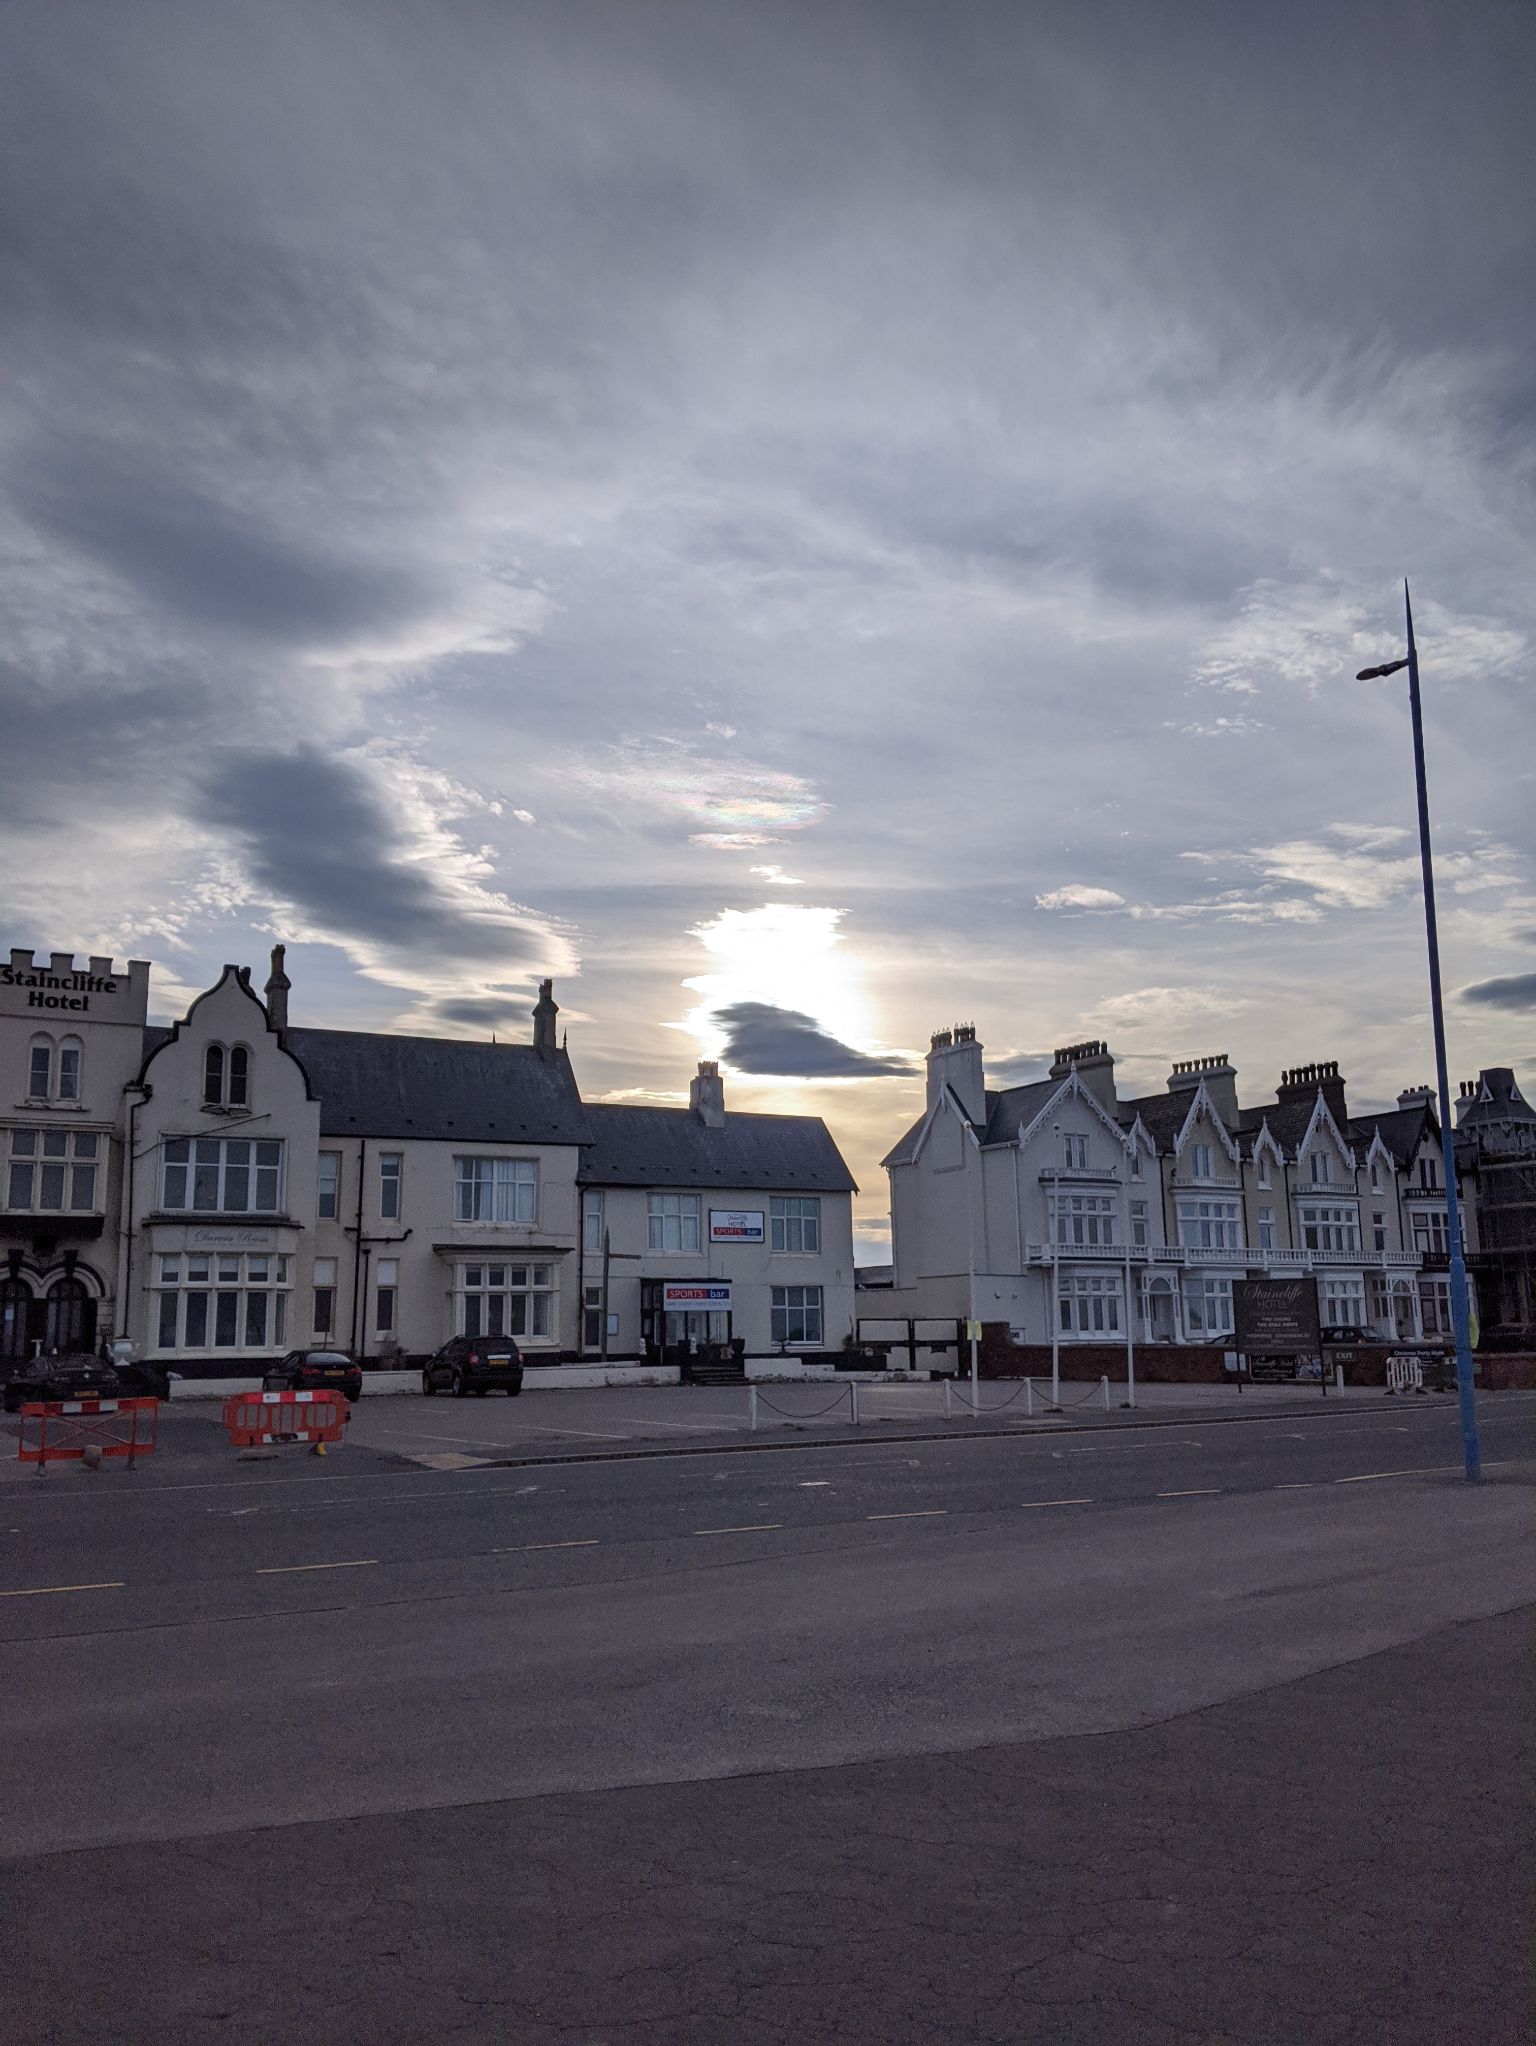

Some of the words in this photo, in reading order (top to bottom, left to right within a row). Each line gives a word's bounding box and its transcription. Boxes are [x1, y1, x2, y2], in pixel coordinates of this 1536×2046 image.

[0, 968, 117, 993] Staincliffe
[28, 991, 89, 1011] Hotel
[669, 1289, 704, 1299] SPORTS
[710, 1289, 725, 1298] bar
[1243, 1281, 1303, 1303] Staincliffe
[1257, 1299, 1288, 1309] HOTEL
